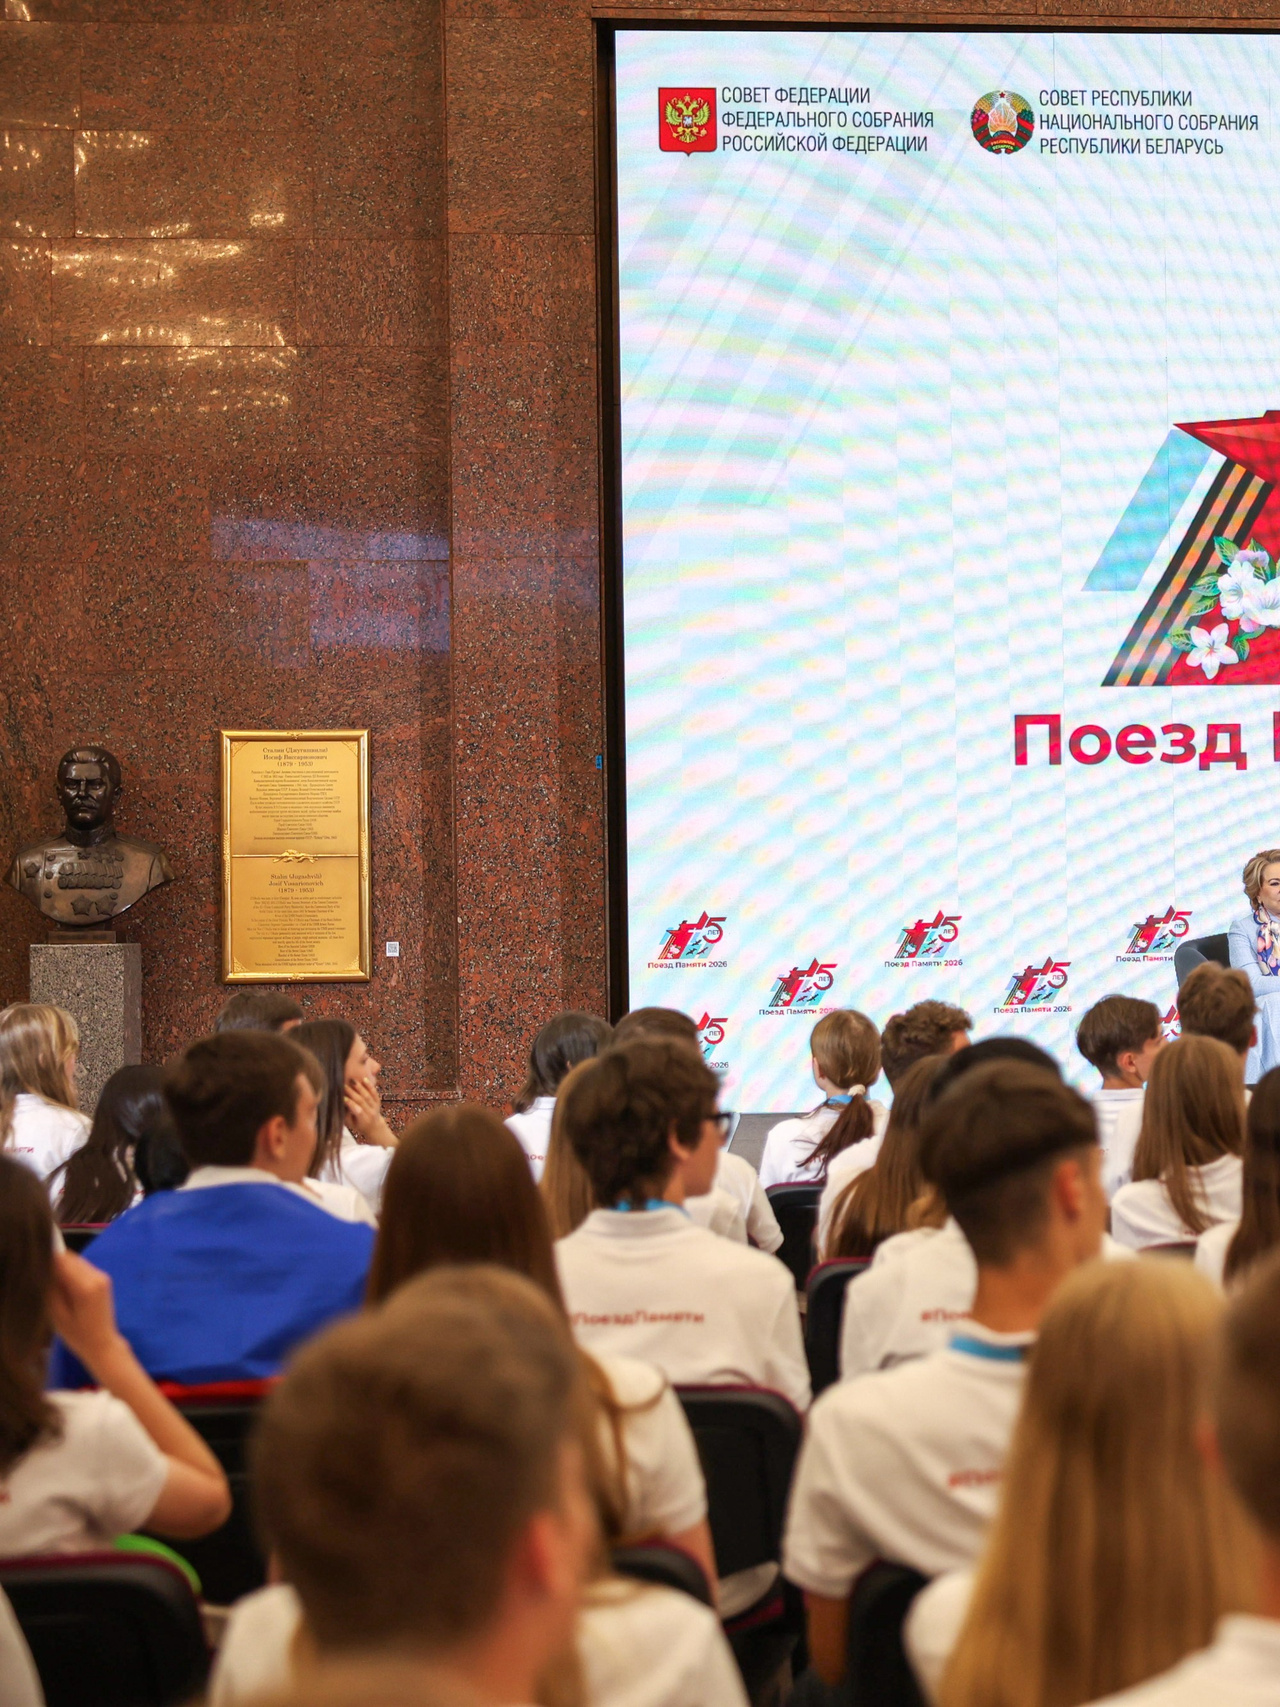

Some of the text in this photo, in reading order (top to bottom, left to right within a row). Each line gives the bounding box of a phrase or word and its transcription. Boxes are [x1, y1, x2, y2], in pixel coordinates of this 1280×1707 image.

[721, 87, 871, 106] СОВЕТ ФЕДЕРАЦИИ
[1039, 90, 1192, 106] СОВЕТ РЕСПУБЛИКИ
[722, 111, 934, 130] ФЕДЕРАЛЬНОГО СОБРАНИЯ
[1039, 114, 1258, 132] НАЦИОНАЛЬНОГО СОБРАНИЯ
[722, 132, 928, 154] РОССИЙСКОЙ ФЕДЕРАЦИИ
[1040, 138, 1224, 154] РЕСПУБЛИКИ БЕЛАРУСЬ
[1013, 712, 1247, 772] Поезд
